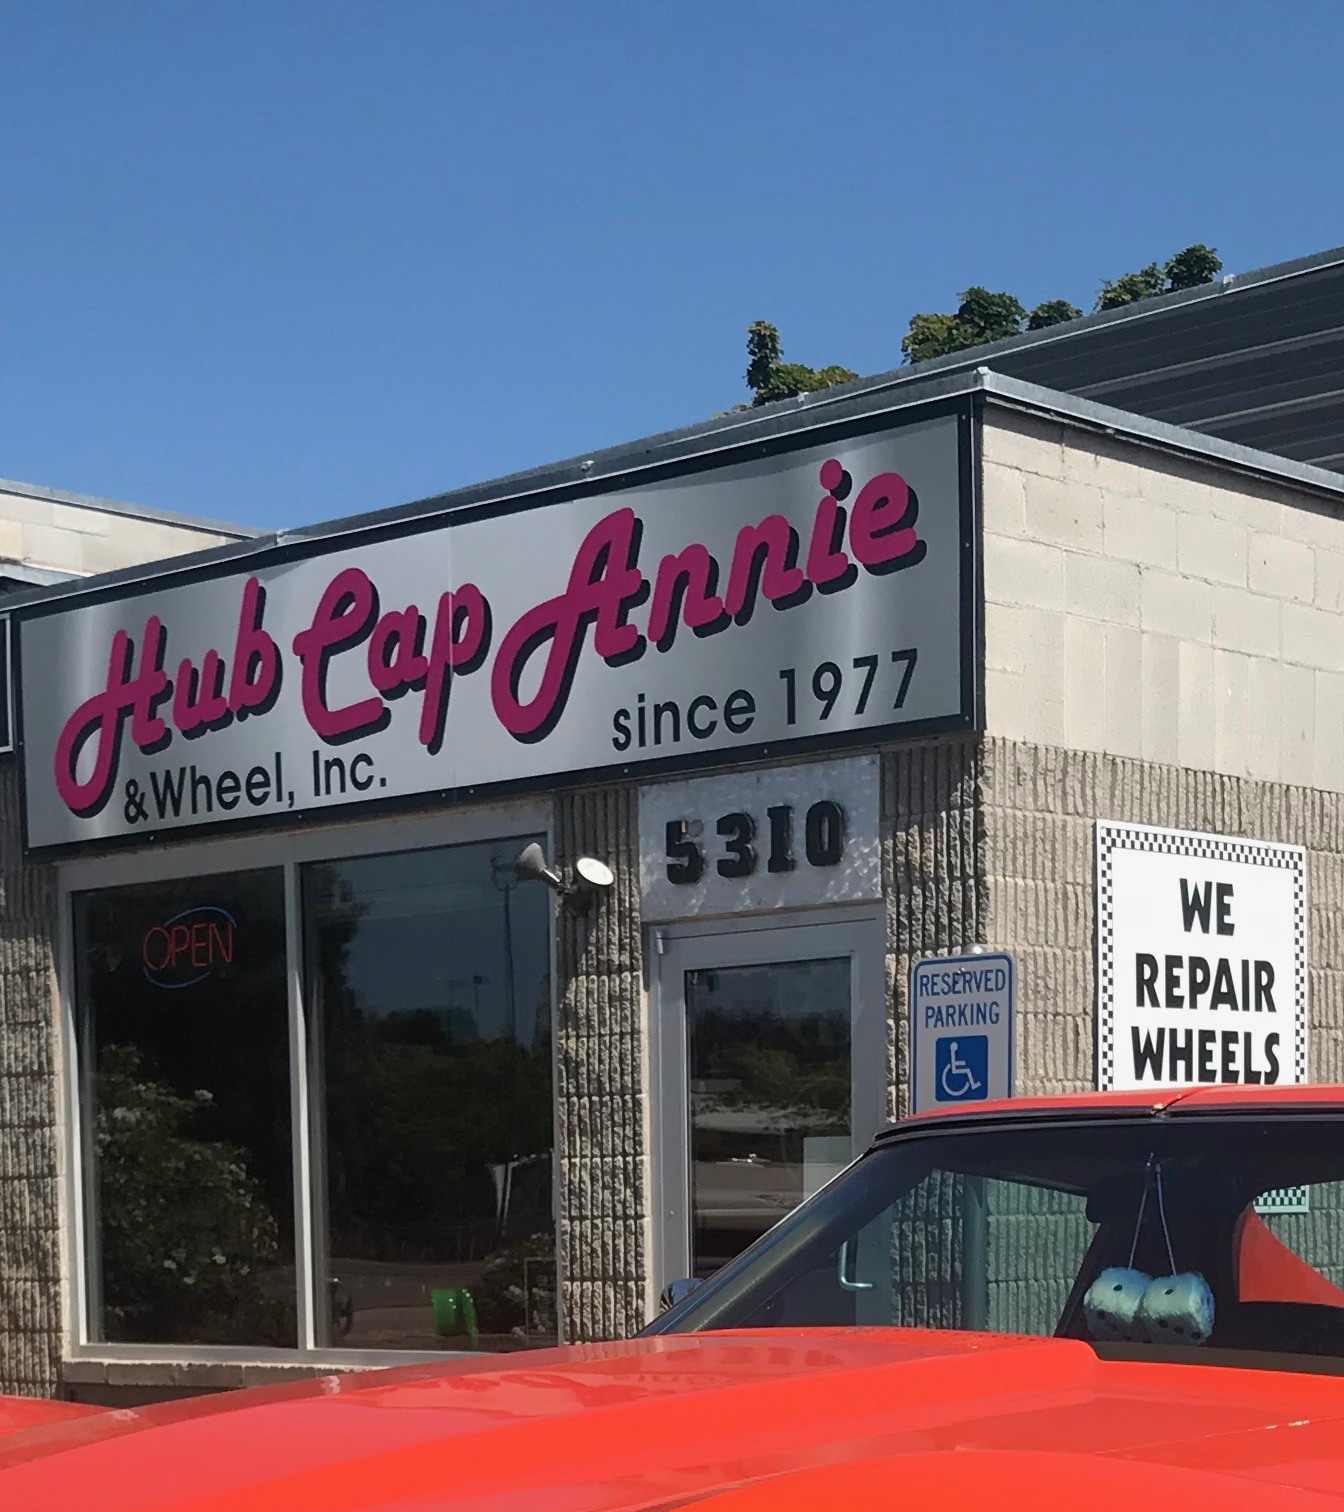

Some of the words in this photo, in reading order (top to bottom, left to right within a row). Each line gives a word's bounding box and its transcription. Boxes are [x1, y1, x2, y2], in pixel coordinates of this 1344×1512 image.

[56, 576, 282, 820] Hub
[292, 566, 494, 756] Cap
[490, 458, 929, 746] Annie
[612, 688, 757, 753] since
[780, 647, 920, 724] 1977
[312, 750, 388, 794] Inc.
[666, 800, 845, 886] 5310
[1179, 878, 1235, 936] WE
[144, 922, 234, 970] OPEN
[919, 968, 1006, 997] RESERVED
[1135, 952, 1277, 1013] REPAIR
[924, 1001, 1000, 1029] PARKING
[1131, 1026, 1280, 1085] WHEELS
